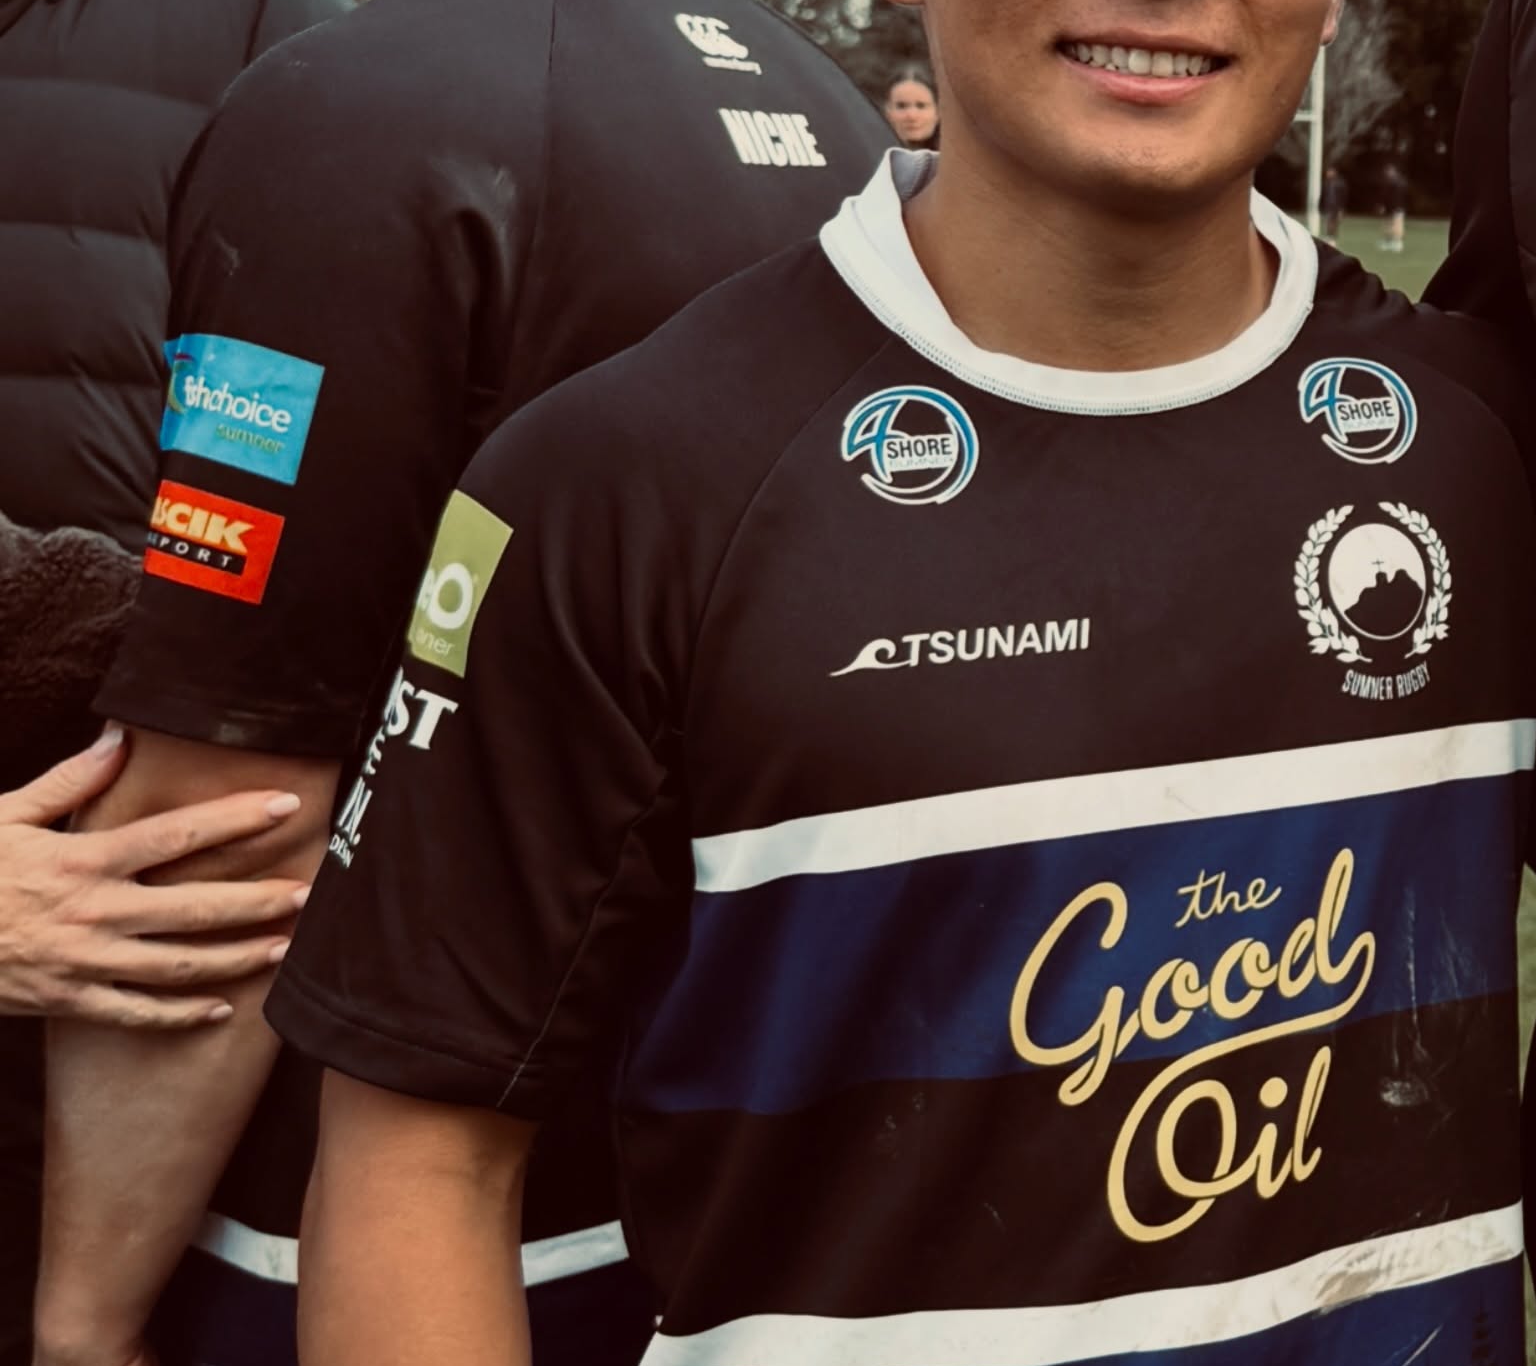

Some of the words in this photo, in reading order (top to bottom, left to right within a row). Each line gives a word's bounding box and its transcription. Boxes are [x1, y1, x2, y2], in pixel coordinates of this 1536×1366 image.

[718, 107, 828, 168] NICHE
[1337, 399, 1395, 421] SHORE
[886, 437, 953, 459] SHORE
[902, 617, 1091, 667] TSUNAMI
[383, 666, 460, 751] ST
[1342, 668, 1393, 701] SUMNER
[1396, 660, 1431, 698] RUGBY
[1174, 869, 1283, 929] the
[1009, 847, 1377, 1106] Good
[1106, 1045, 1332, 1243] Oil
